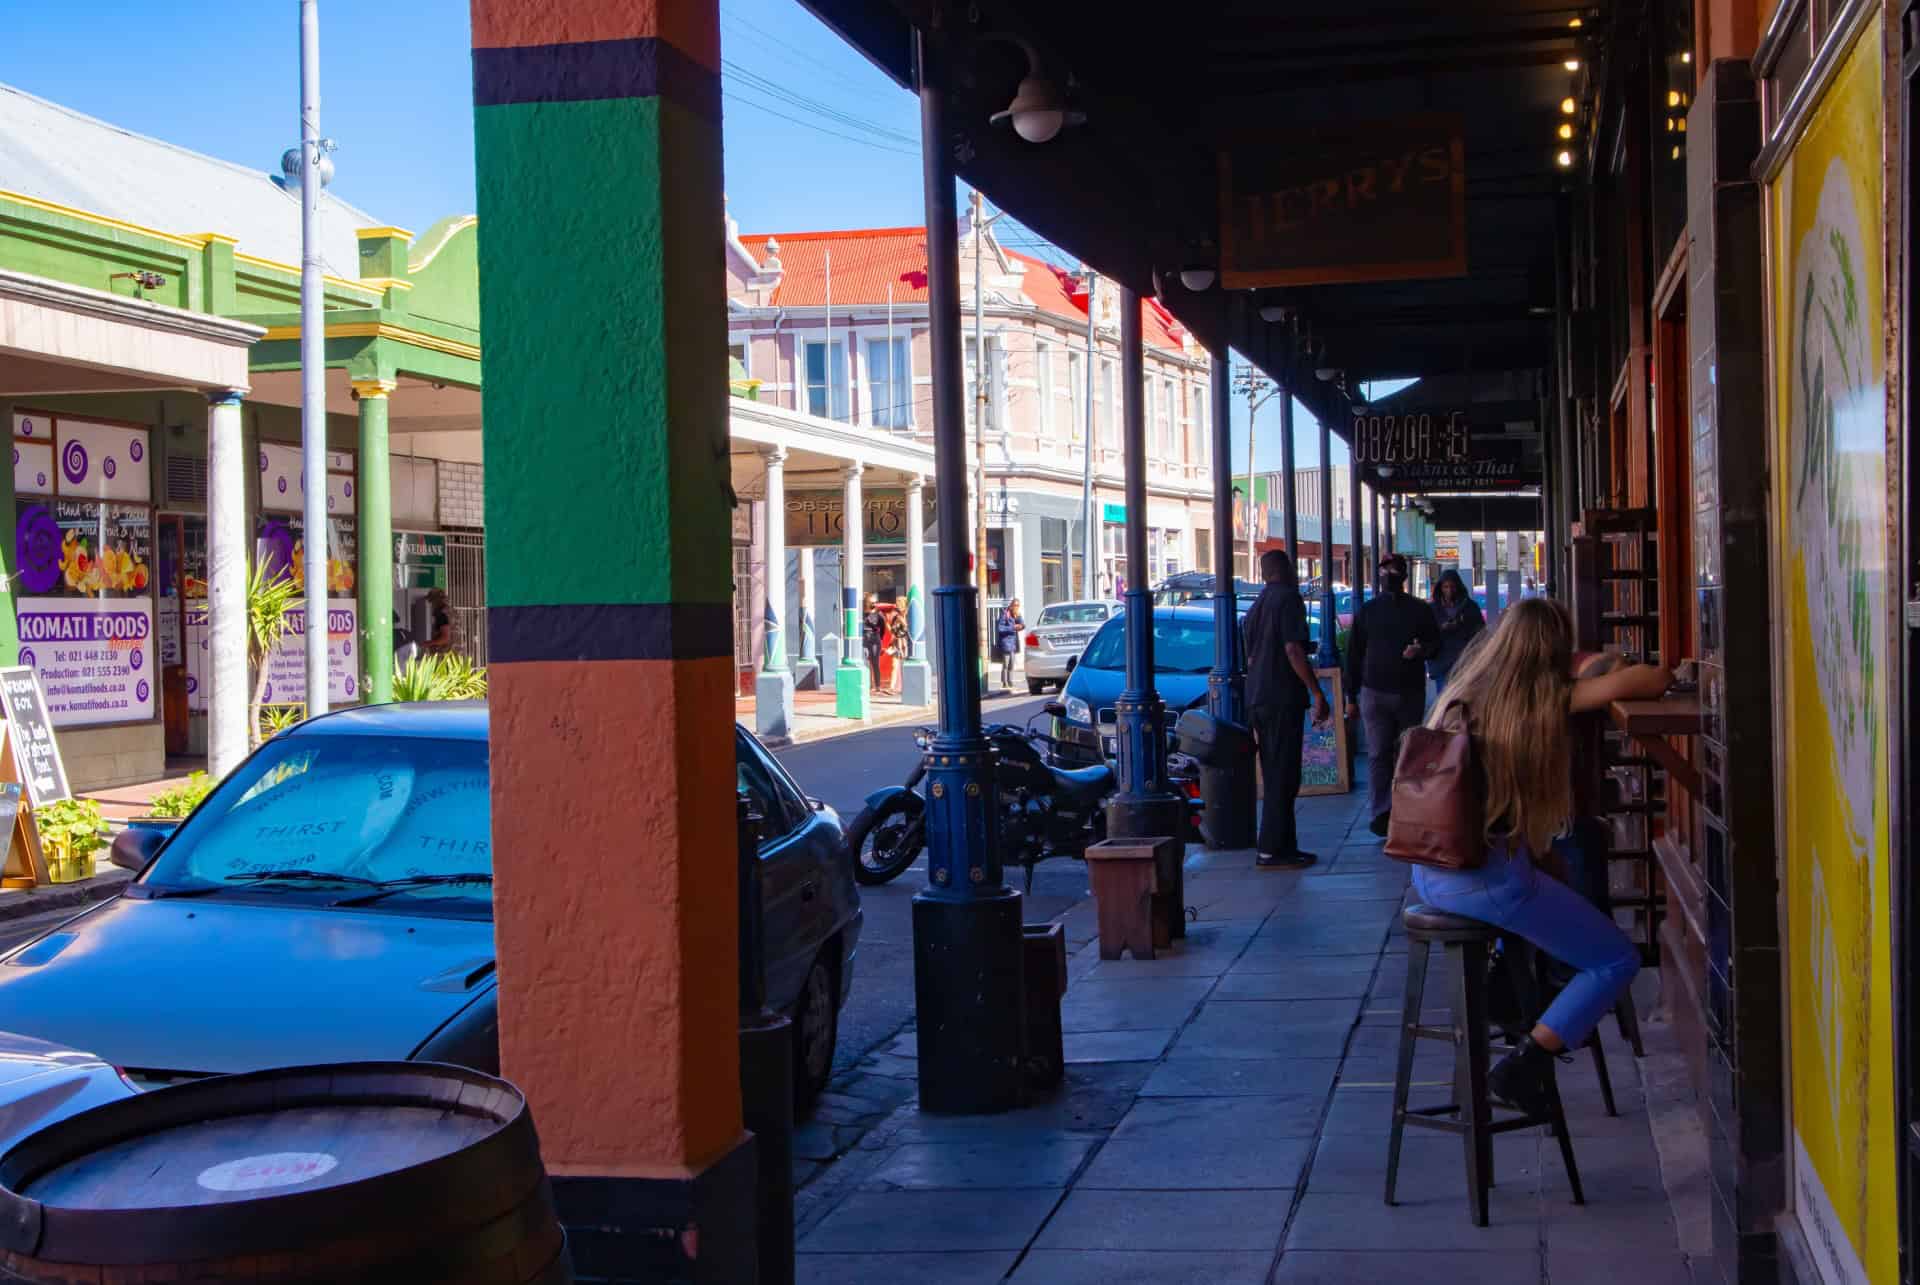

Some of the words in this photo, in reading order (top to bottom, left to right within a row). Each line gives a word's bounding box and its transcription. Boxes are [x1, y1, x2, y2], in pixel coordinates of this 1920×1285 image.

[20, 616, 88, 639] KOMATI
[93, 616, 147, 638] FOODS
[256, 819, 347, 839] THIRST
[419, 835, 489, 854] THIR
